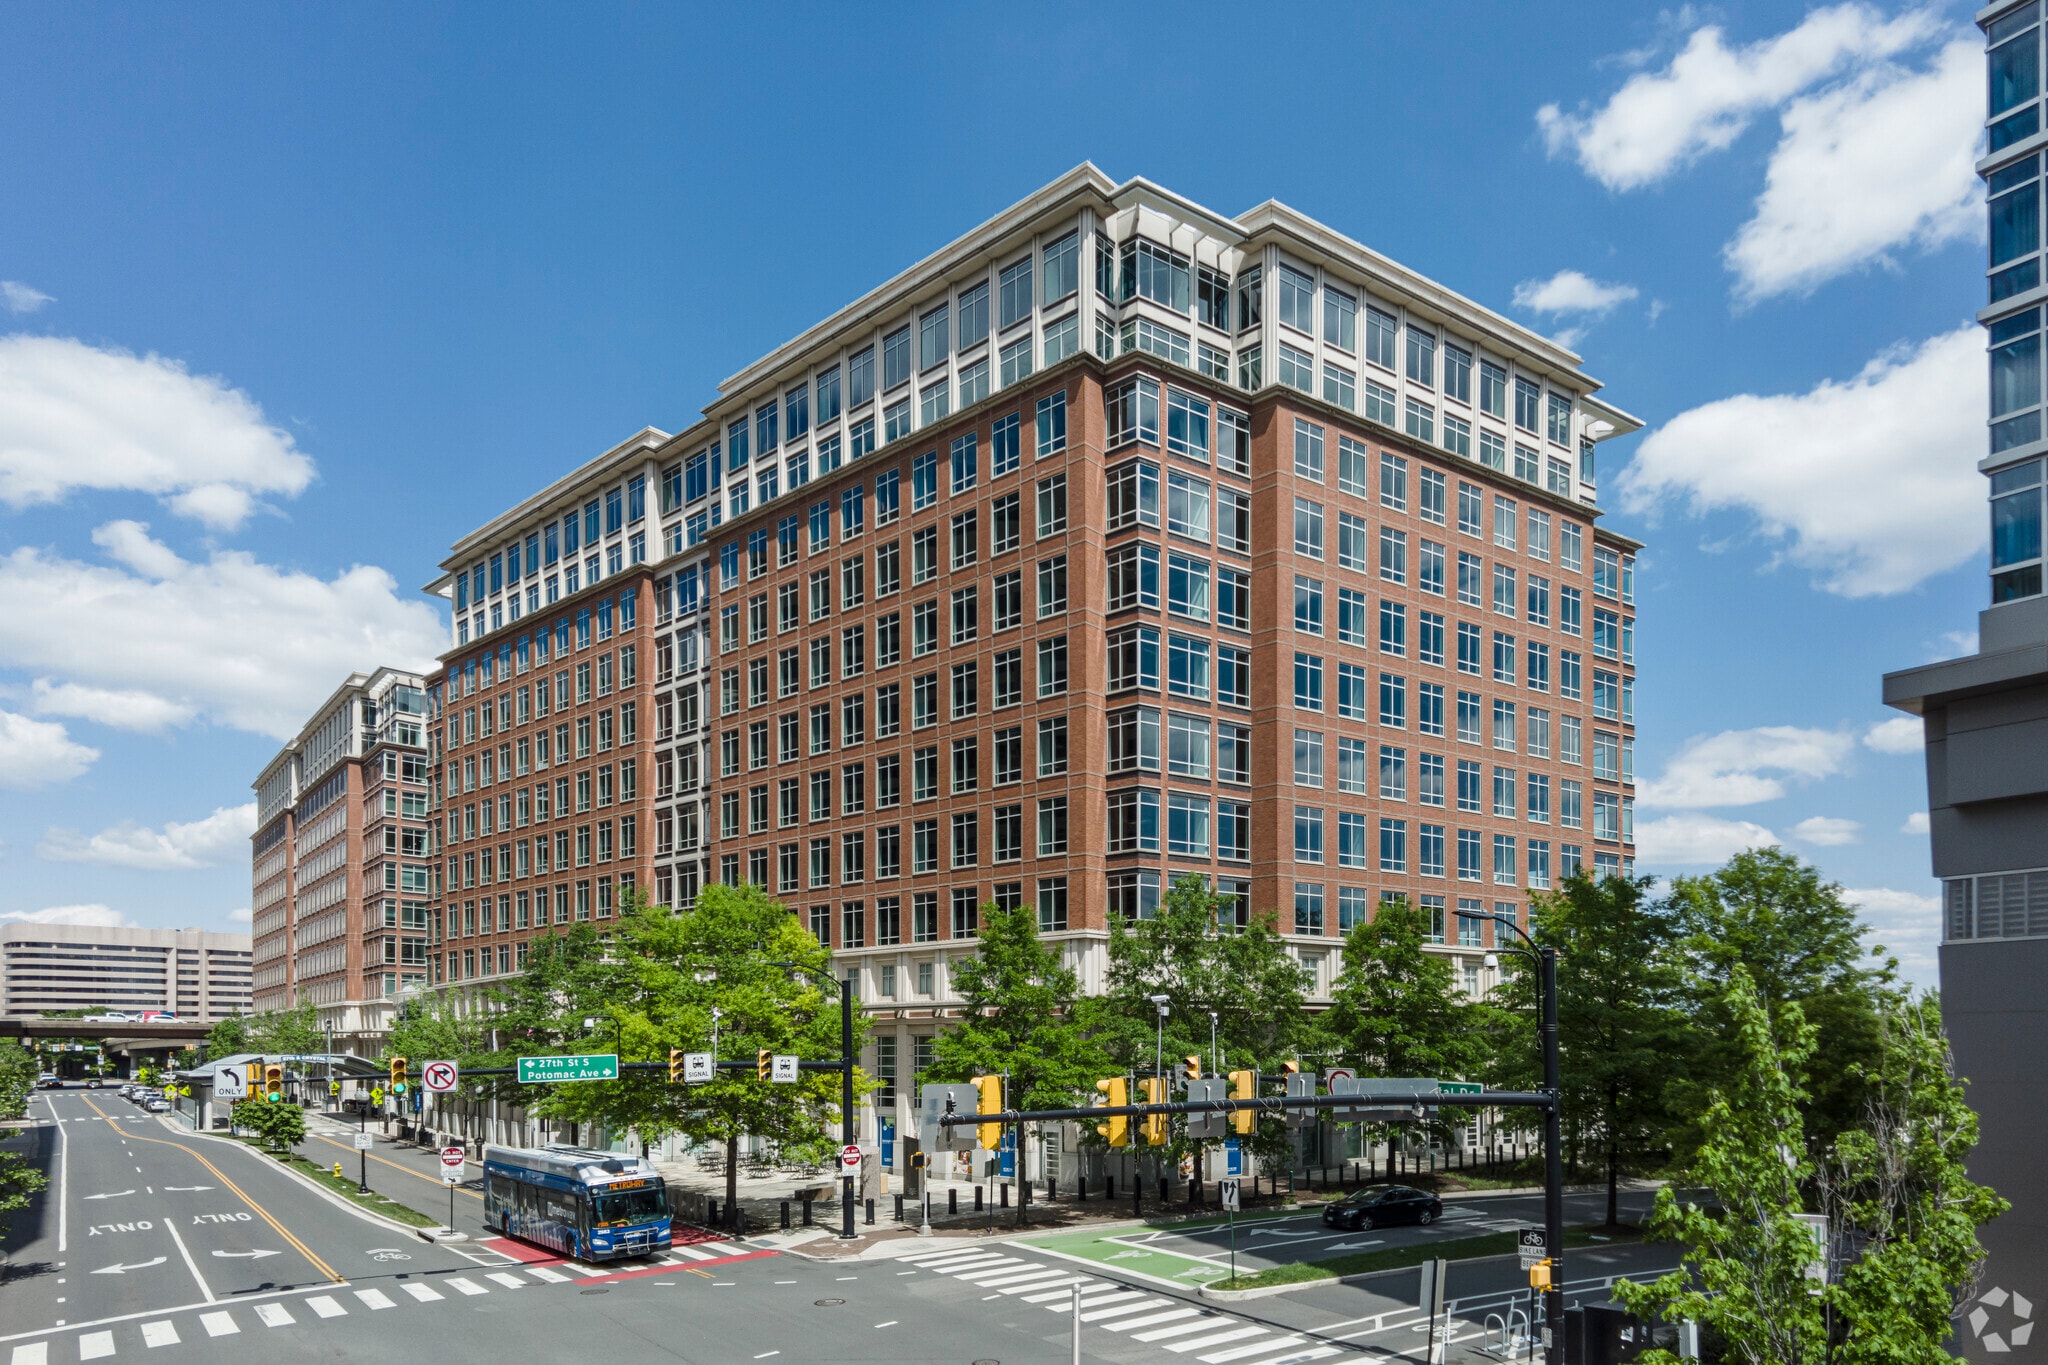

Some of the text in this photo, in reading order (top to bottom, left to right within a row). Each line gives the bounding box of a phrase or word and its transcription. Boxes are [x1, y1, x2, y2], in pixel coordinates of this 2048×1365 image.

[539, 1058, 590, 1068] 27th St S
[528, 1069, 600, 1080] Potomac Ave
[609, 1179, 645, 1191] METROWAY
[192, 1212, 252, 1225] ONLY
[88, 1221, 153, 1236] ONLY
[1519, 1246, 1533, 1255] BIKE
